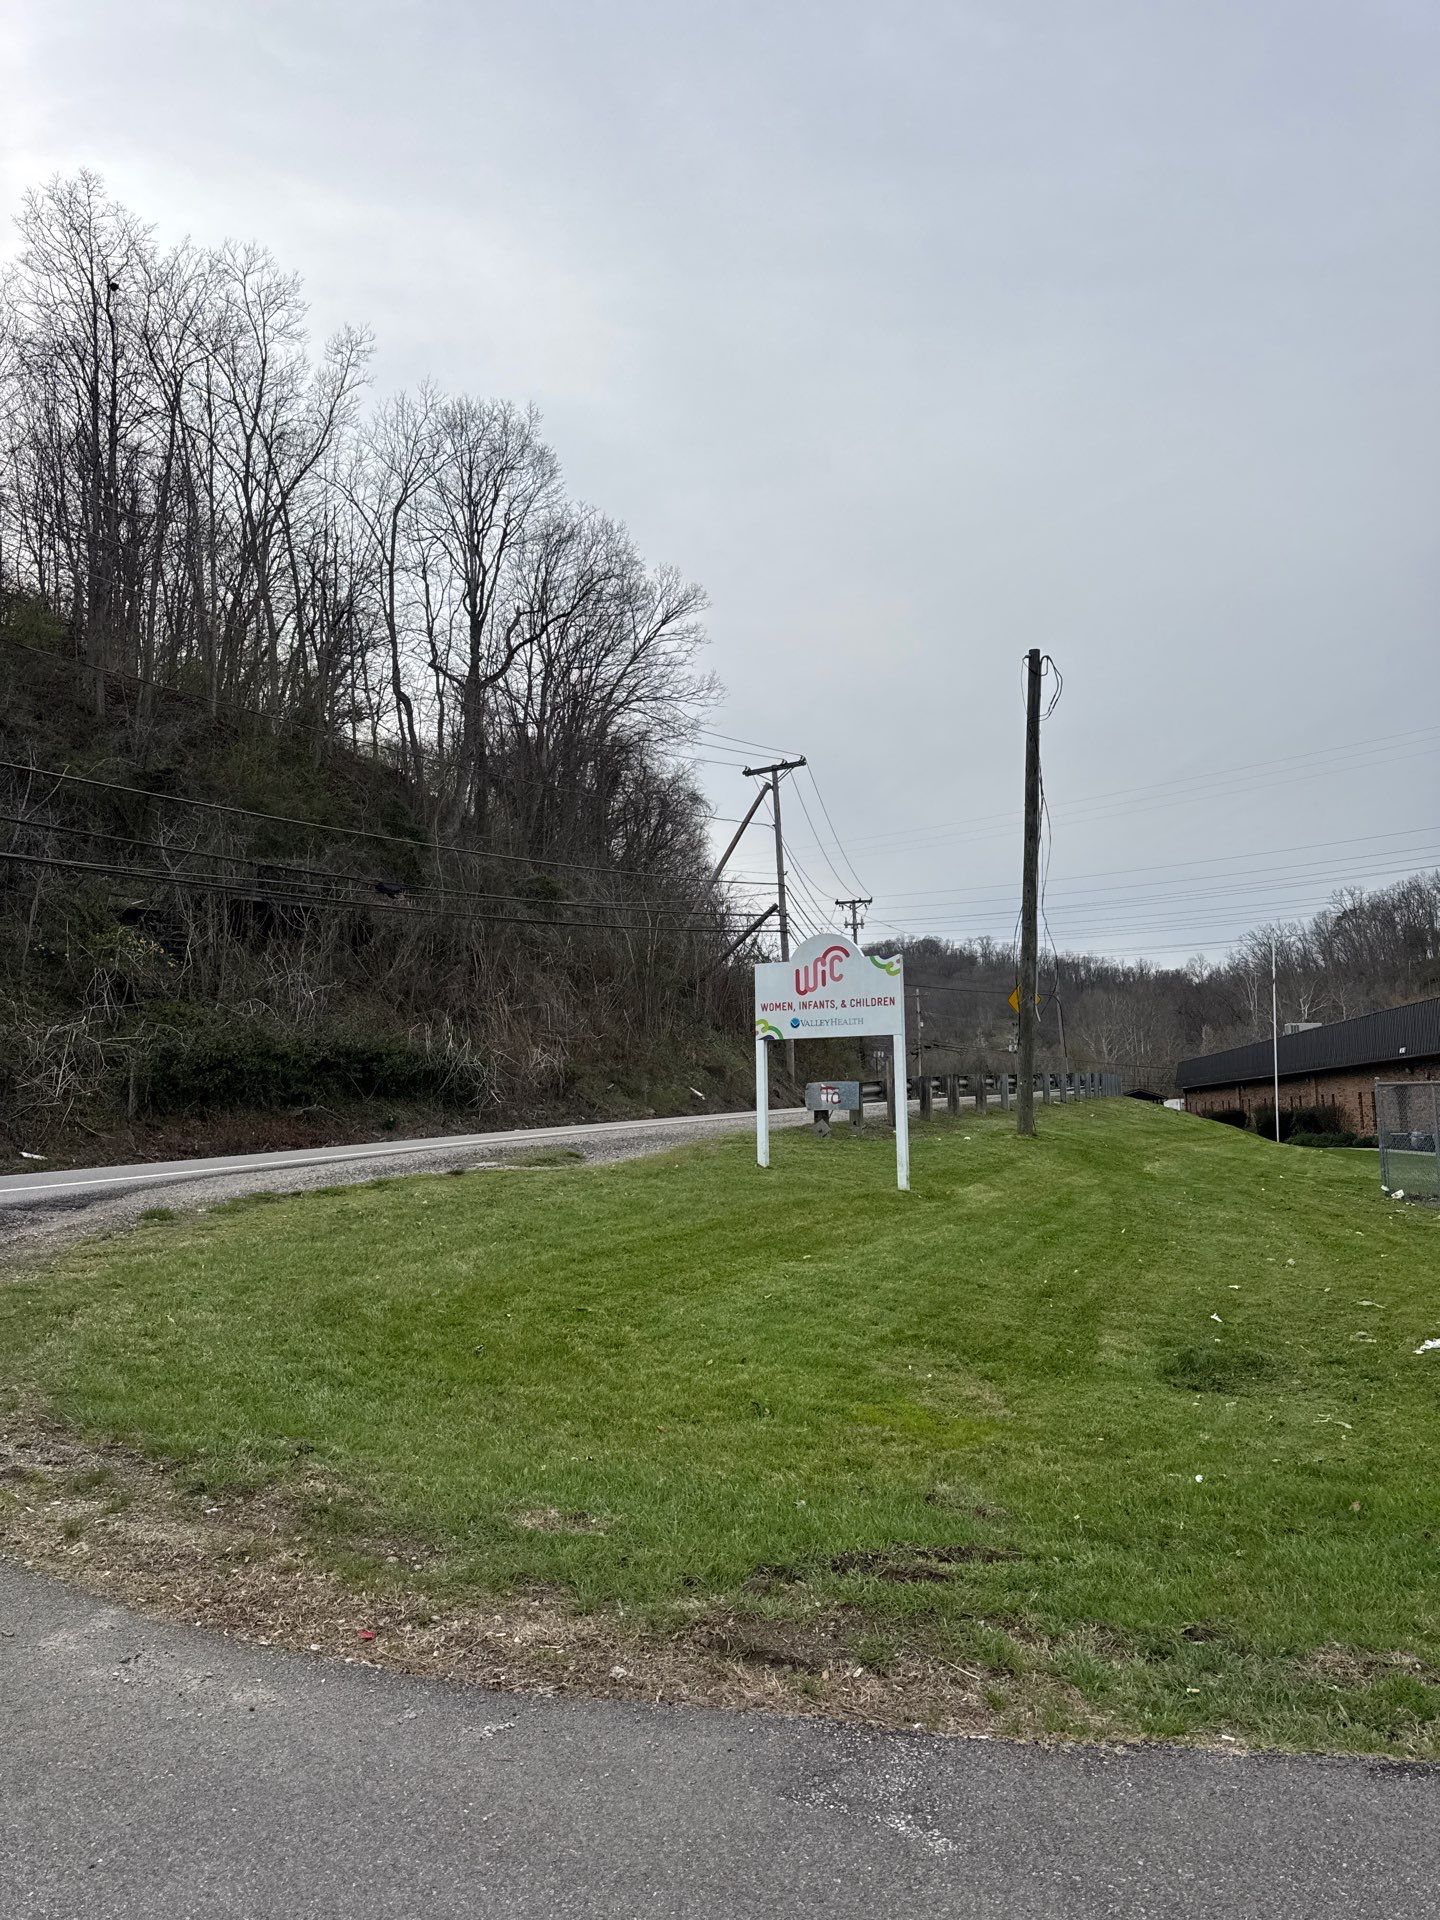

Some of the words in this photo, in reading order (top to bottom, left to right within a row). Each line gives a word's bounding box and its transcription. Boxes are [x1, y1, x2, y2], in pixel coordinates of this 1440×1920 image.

[761, 1001, 796, 1012] WOMEN,
[799, 999, 838, 1010] INFANTS,
[840, 999, 847, 1008] &
[850, 996, 896, 1007] CHILDREN
